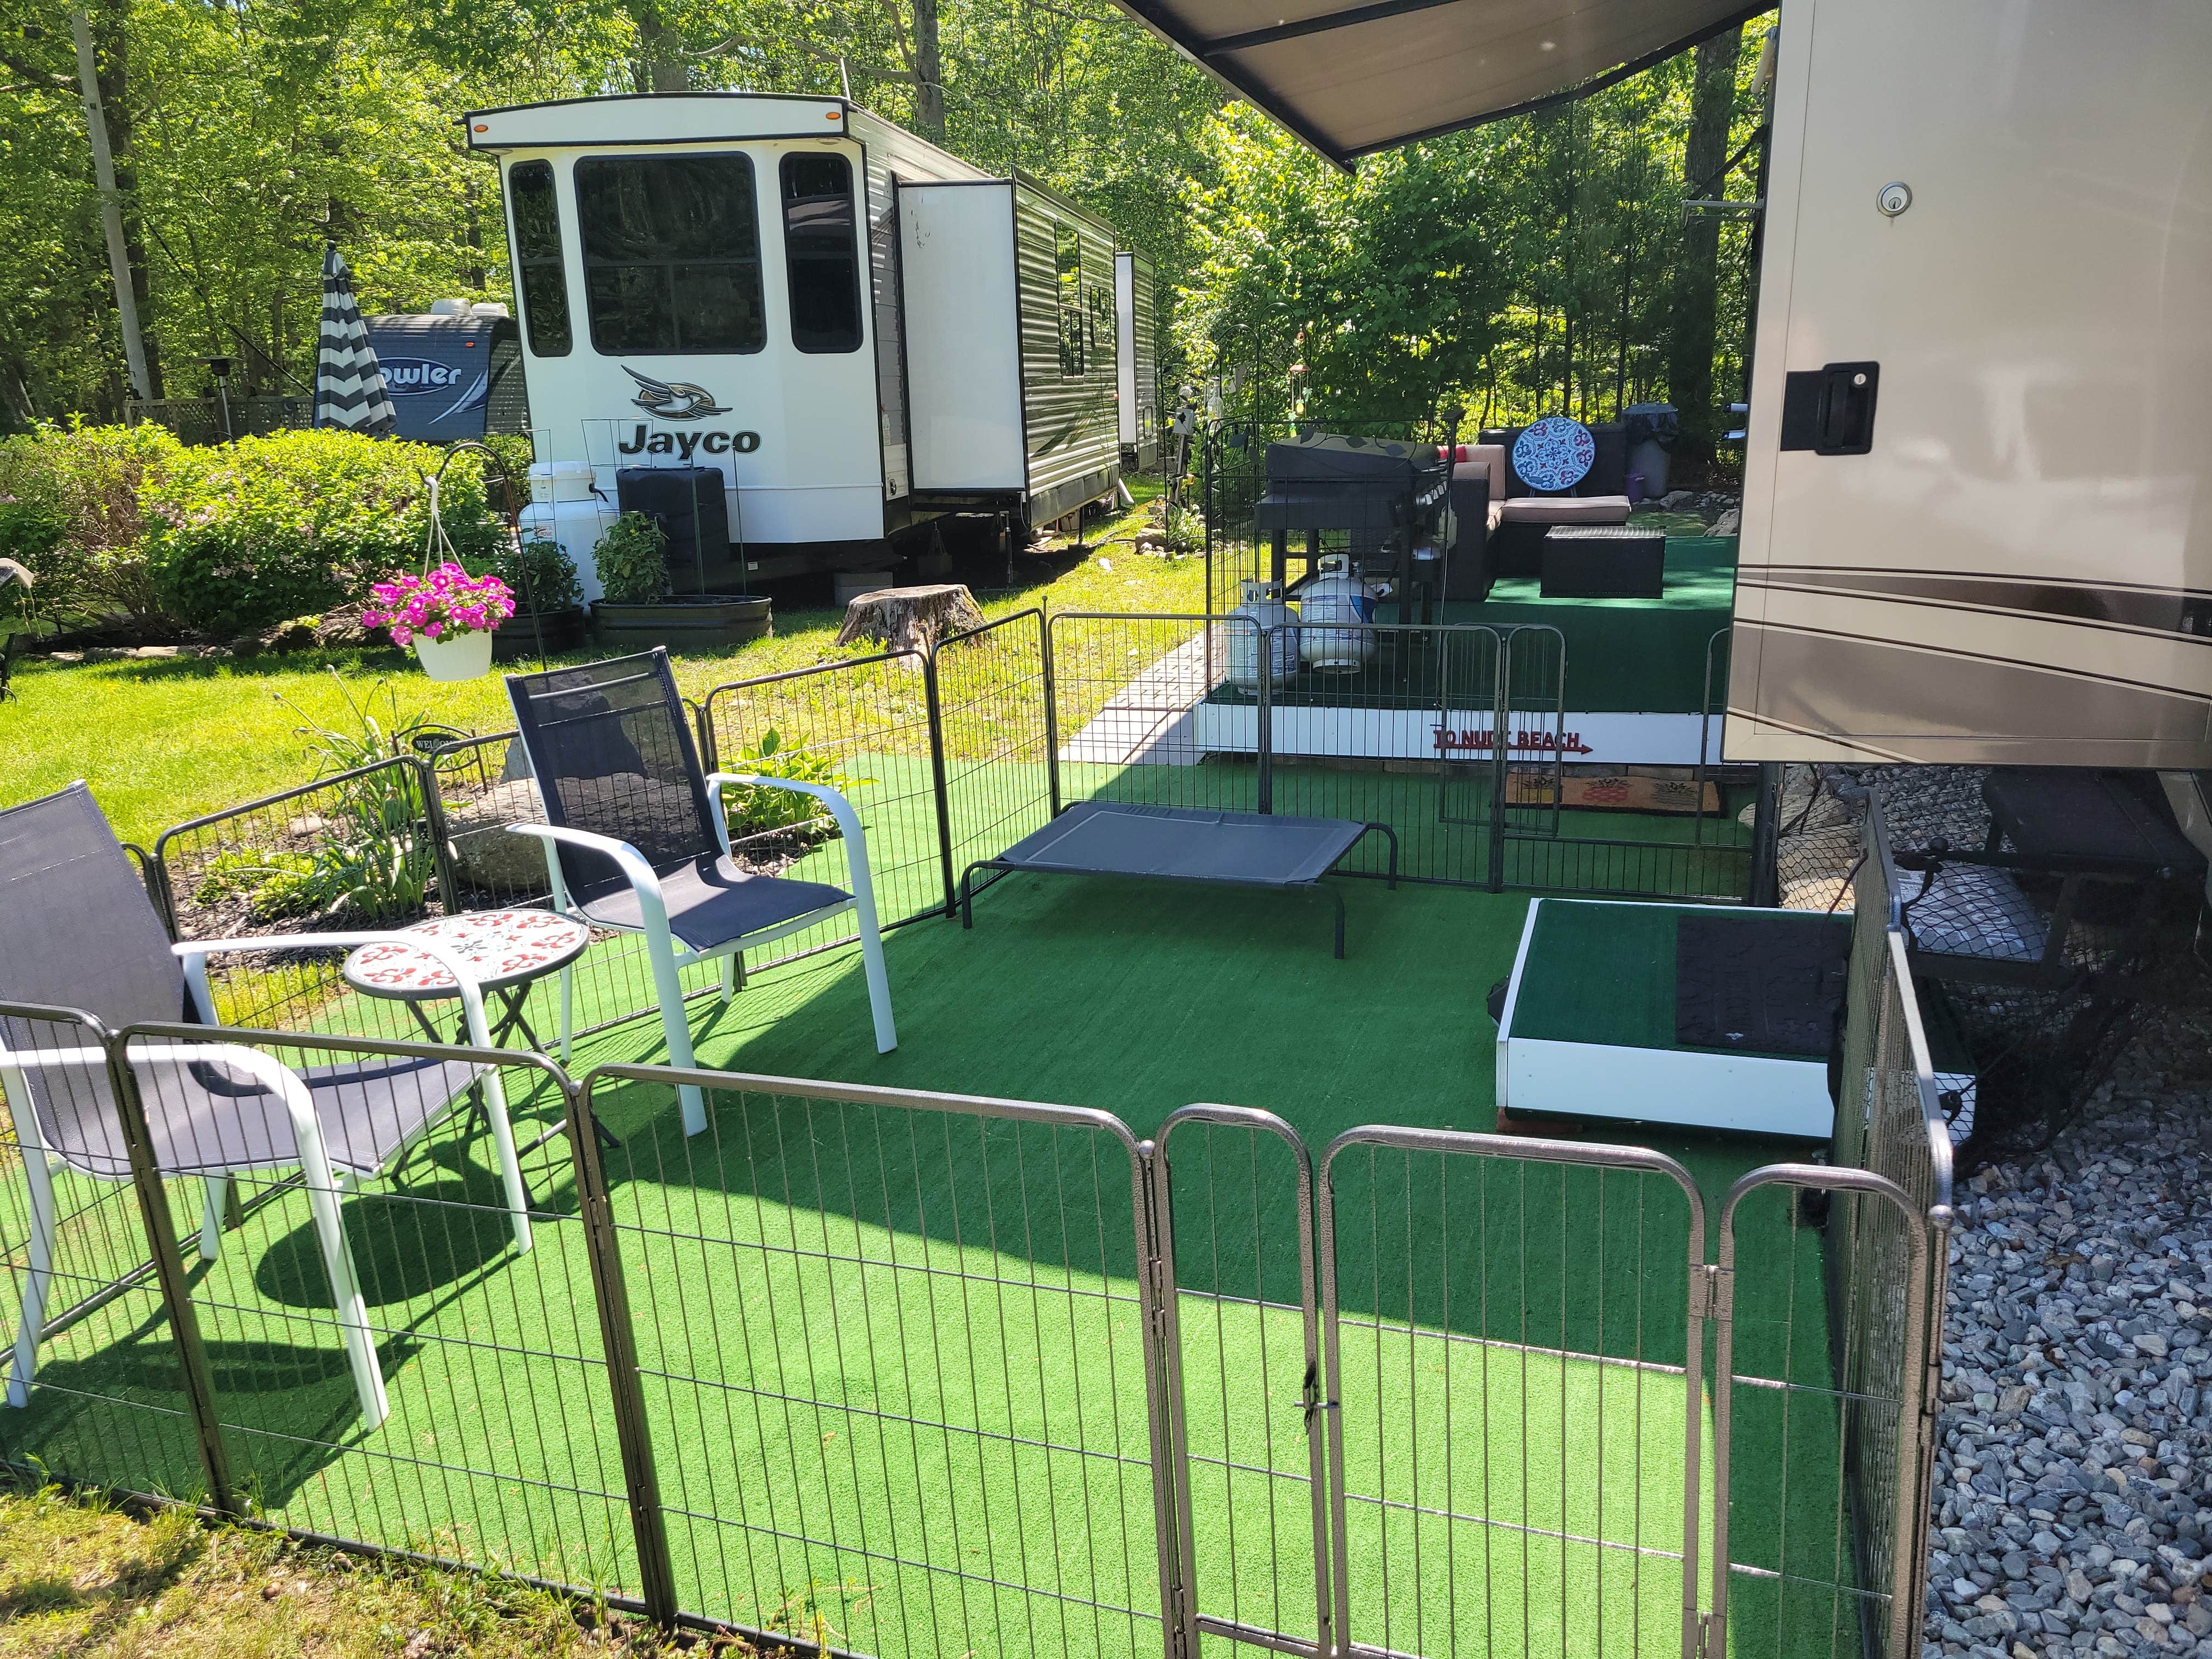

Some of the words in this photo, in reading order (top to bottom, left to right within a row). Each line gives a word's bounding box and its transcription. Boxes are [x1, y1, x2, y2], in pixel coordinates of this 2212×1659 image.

[379, 364, 462, 385] owler
[618, 424, 762, 461] Jayco
[1434, 730, 1457, 745] TO
[1517, 731, 1579, 747] BEACH
